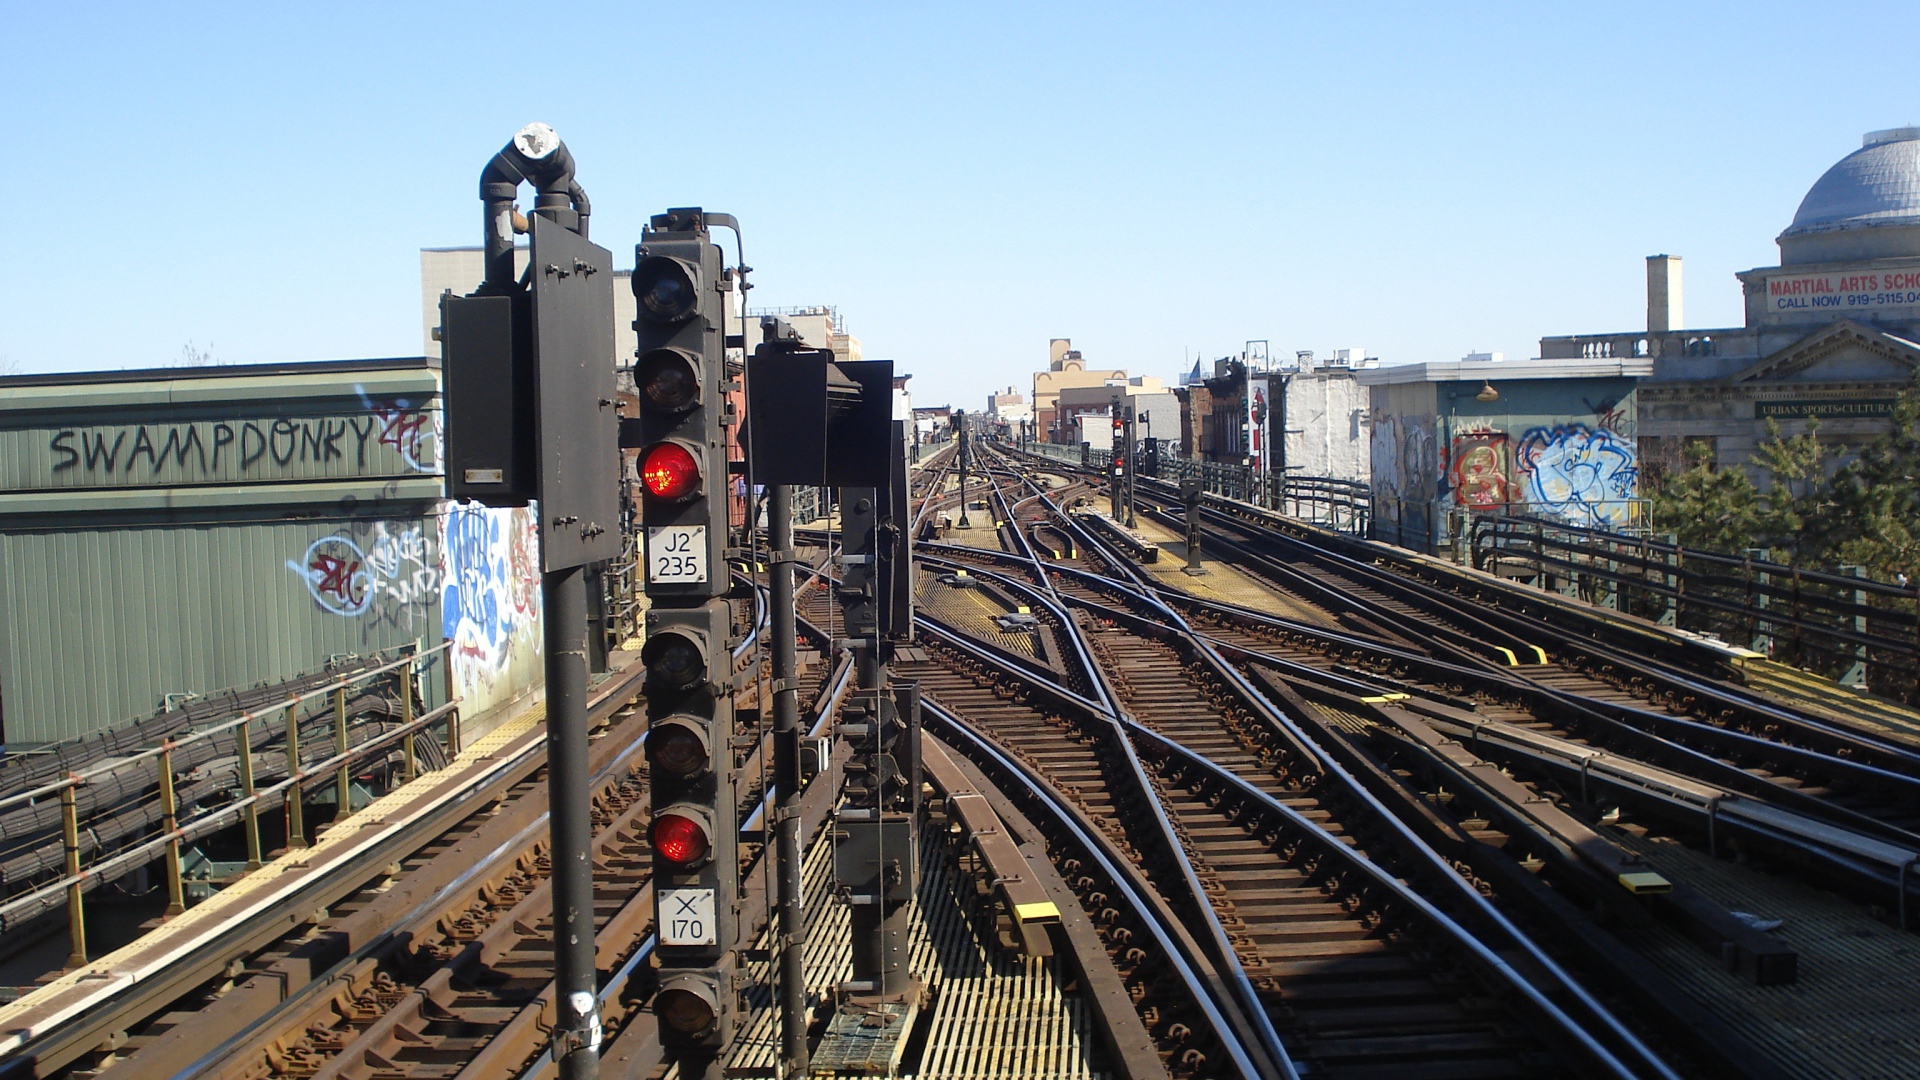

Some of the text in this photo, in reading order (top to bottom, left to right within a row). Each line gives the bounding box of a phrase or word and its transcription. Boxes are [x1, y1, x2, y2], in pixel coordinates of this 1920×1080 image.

[1770, 278, 1834, 296] MARTIAL
[1839, 275, 1879, 292] ARTS
[1777, 298, 1809, 309] CALL
[1811, 295, 1842, 307] NOW
[1763, 405, 1799, 415] URBAN
[50, 416, 374, 475] SWAMPDONKY
[664, 533, 690, 552] J2
[658, 557, 697, 576] 235
[675, 896, 697, 915] X
[672, 919, 703, 939] 170
